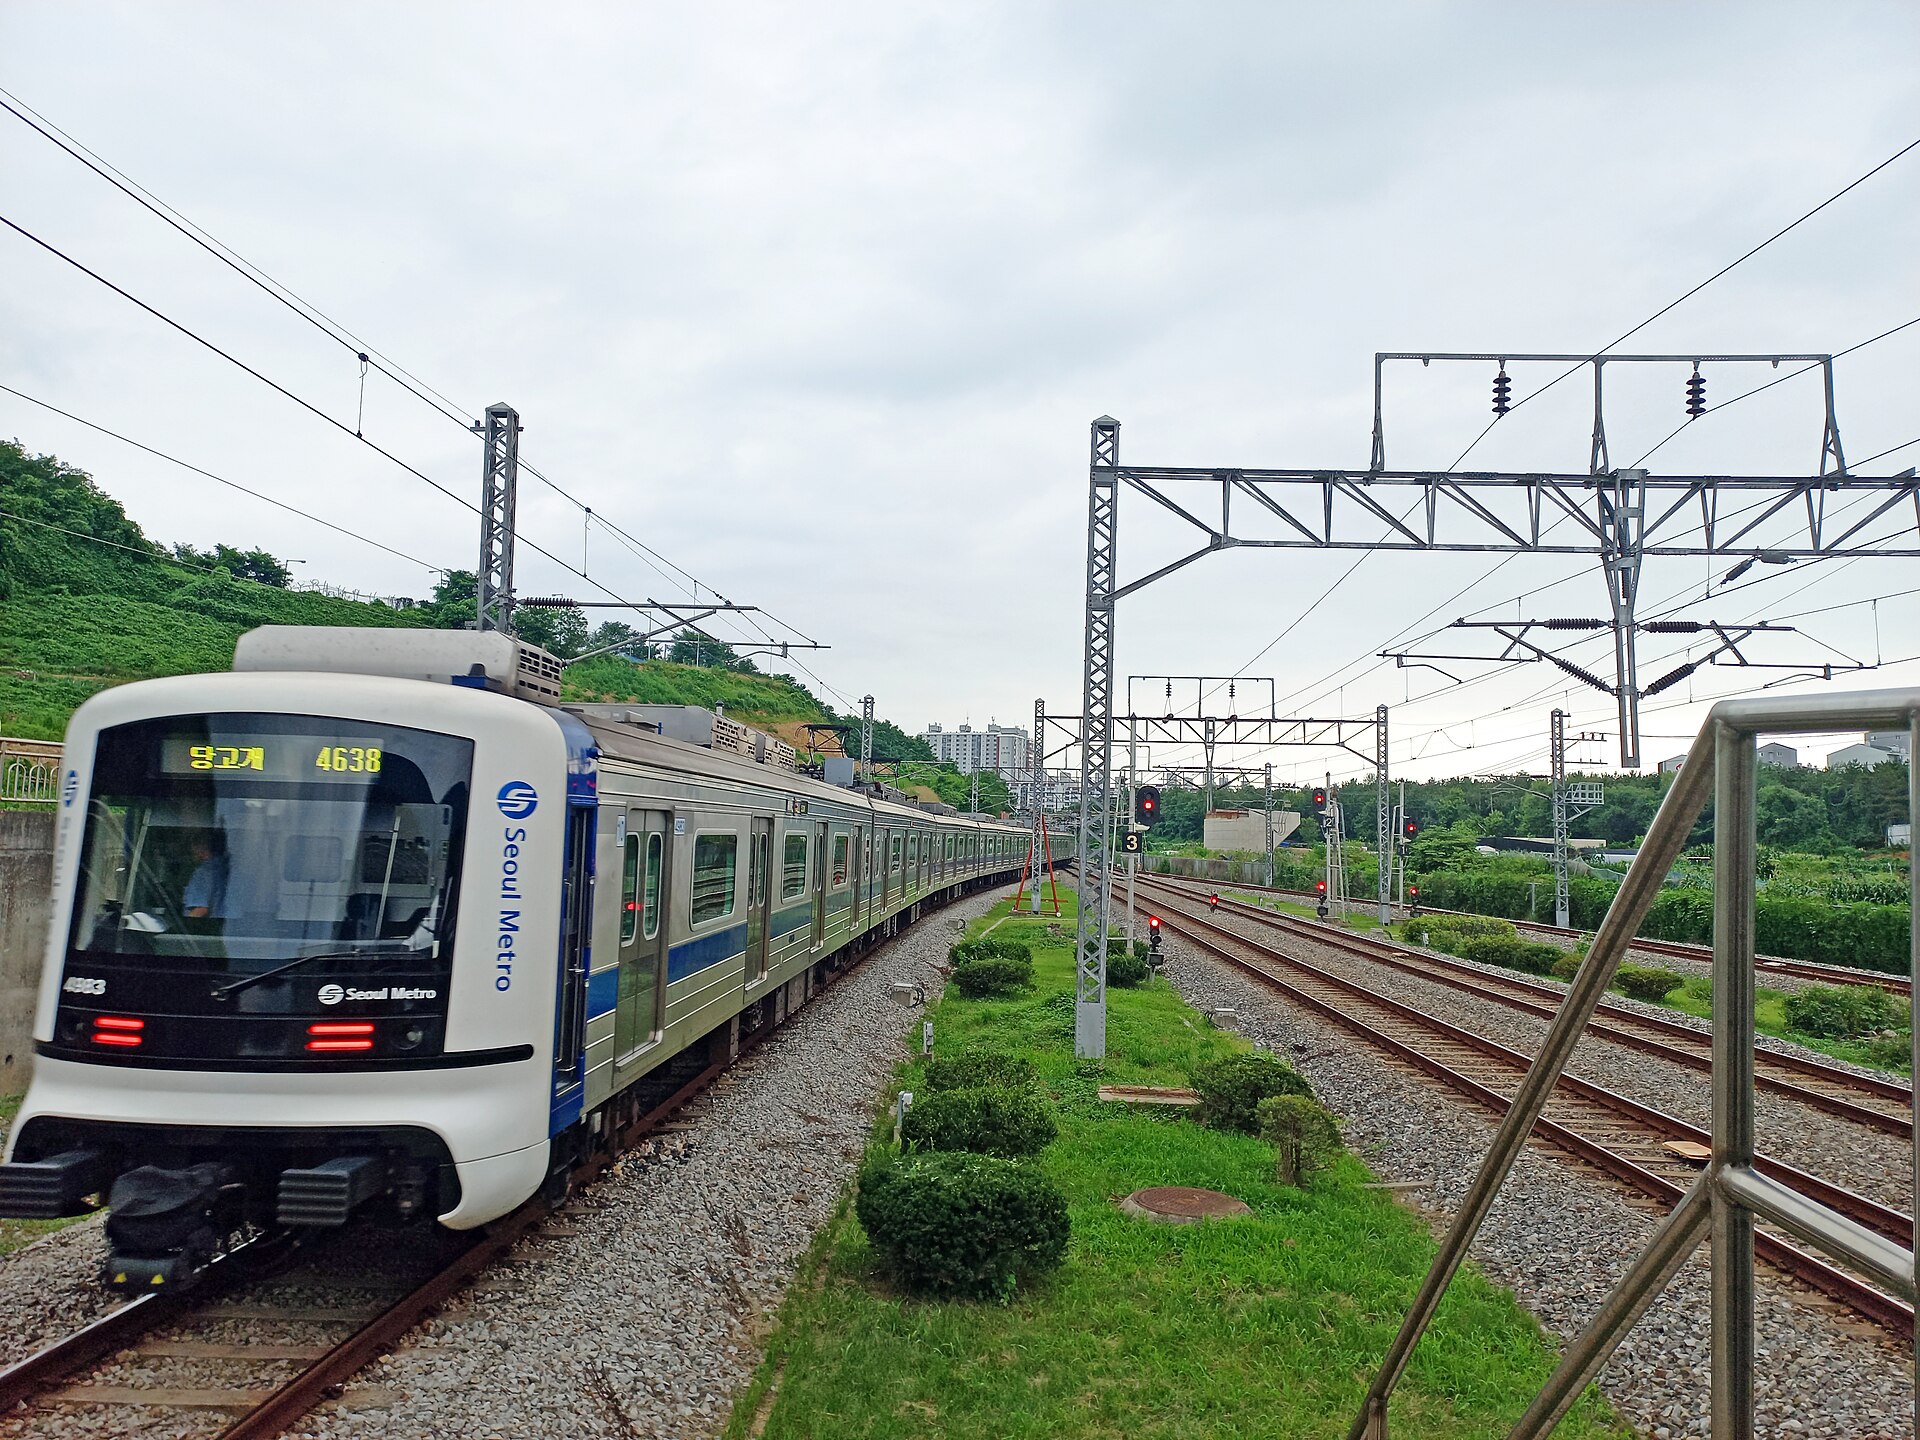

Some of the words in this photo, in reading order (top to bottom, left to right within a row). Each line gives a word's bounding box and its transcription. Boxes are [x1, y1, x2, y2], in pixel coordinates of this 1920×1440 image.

[189, 745, 264, 770] 당고개
[315, 746, 382, 772] 4638
[1126, 835, 1138, 850] 3
[501, 827, 526, 899] Seoul
[495, 910, 520, 992] Metro
[345, 987, 388, 1000] Seoul
[391, 987, 437, 999] Metro
